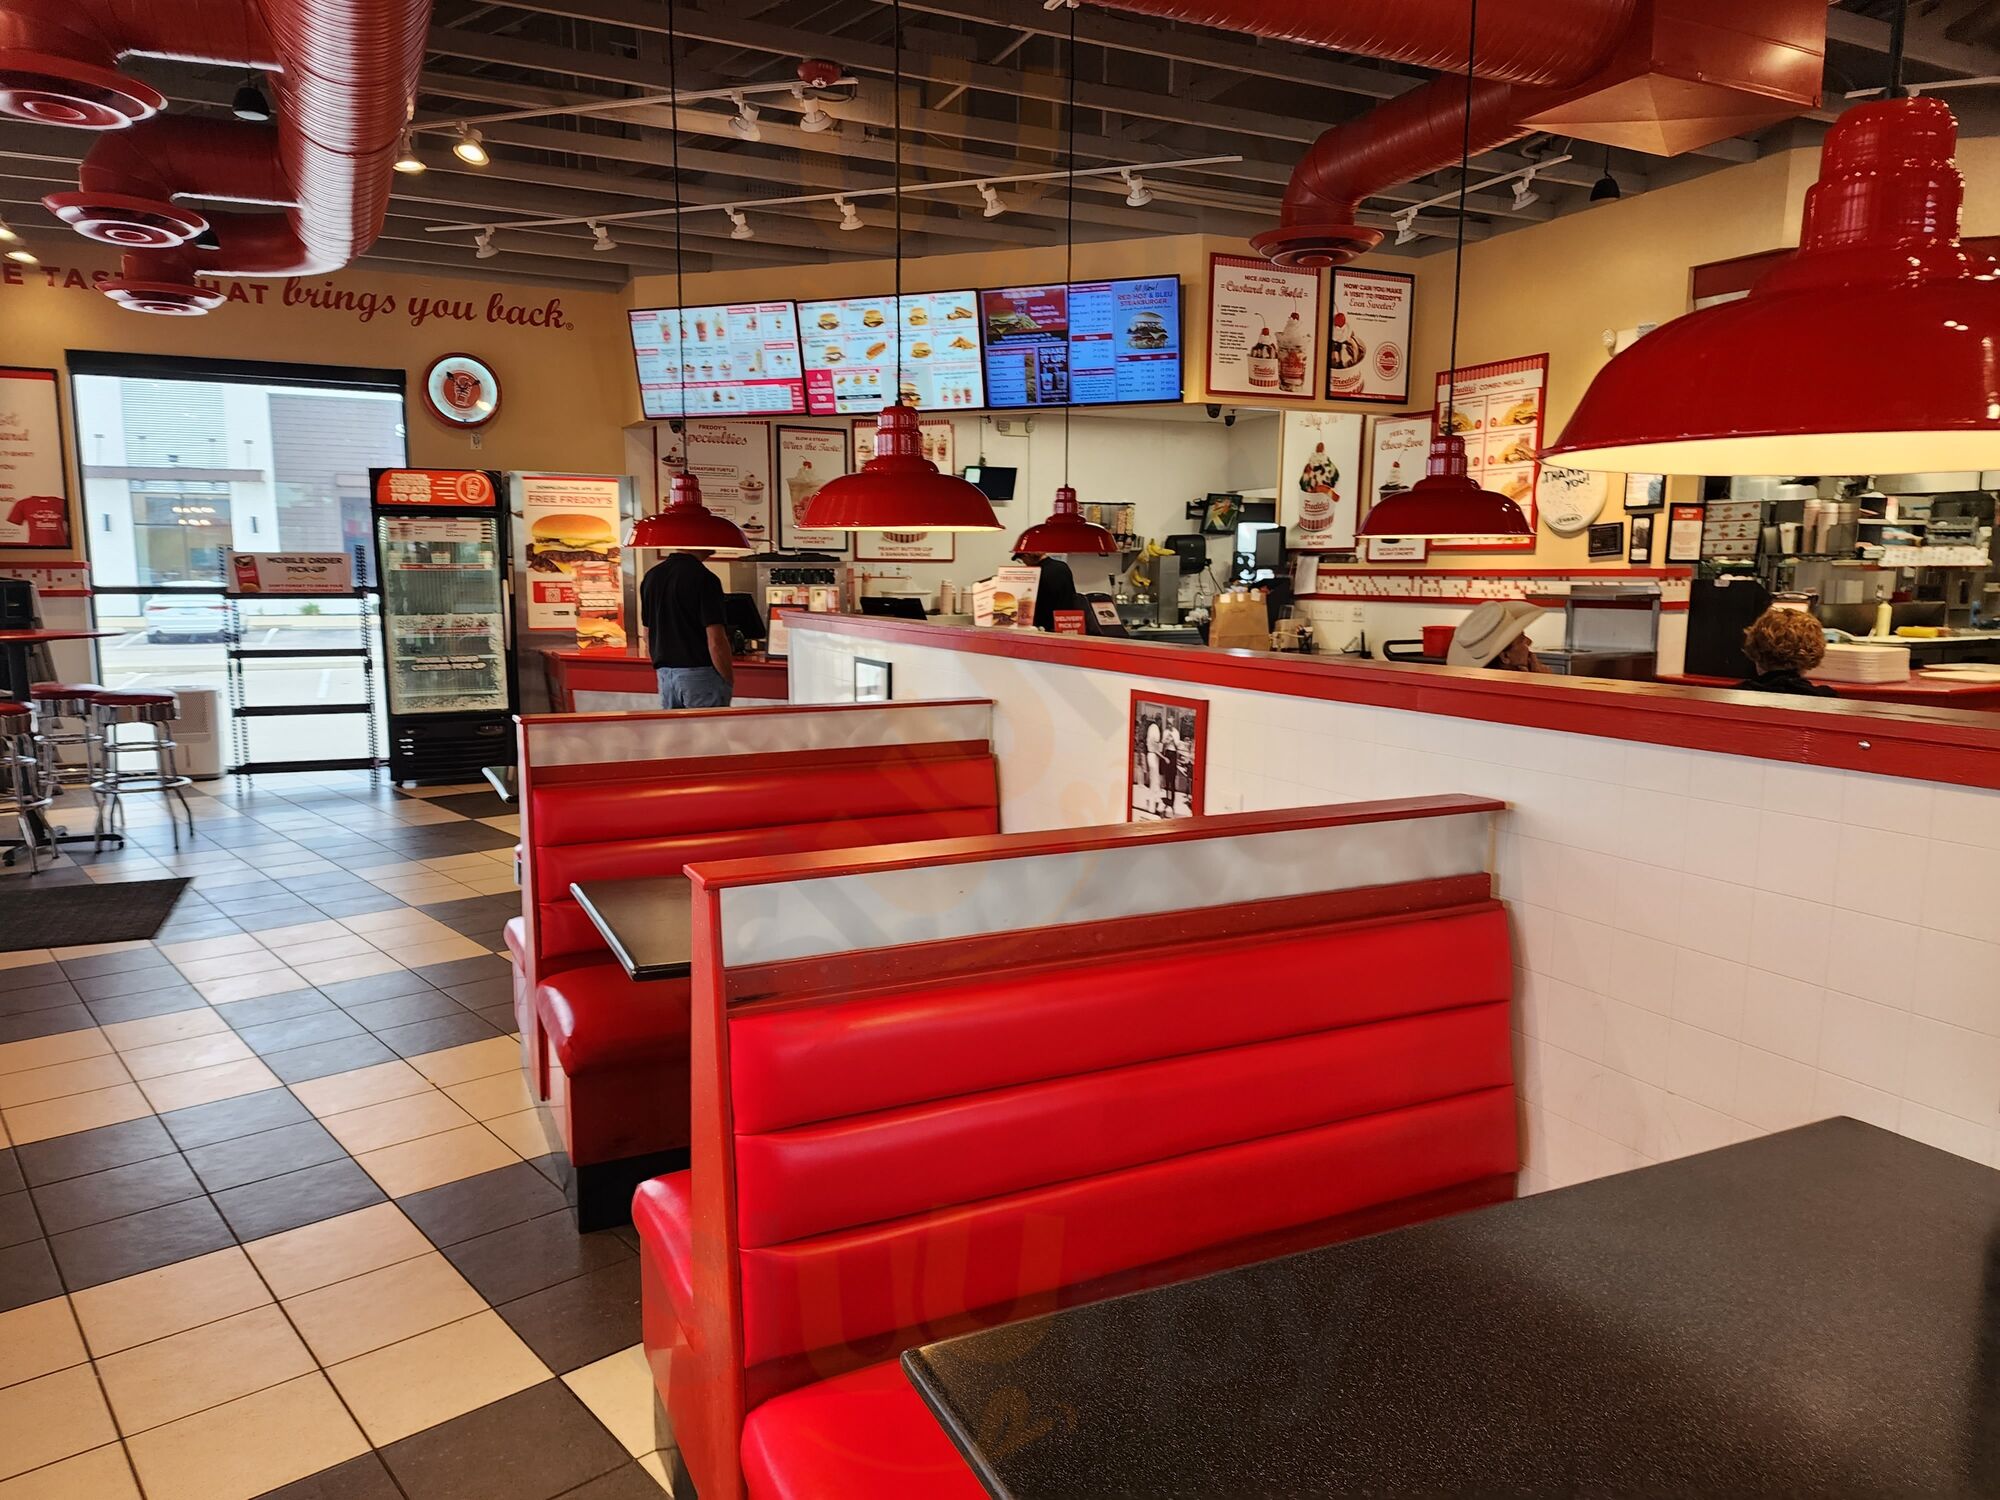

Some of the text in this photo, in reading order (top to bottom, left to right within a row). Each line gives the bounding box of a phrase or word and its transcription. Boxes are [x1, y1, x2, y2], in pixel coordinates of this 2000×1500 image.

[1244, 274, 1258, 282] NICE
[1225, 280, 1304, 299] Custard on Hold
[1343, 282, 1359, 290] HOW
[1385, 287, 1403, 295] MAKE
[1154, 290, 1174, 298] BLEU
[1349, 290, 1365, 298] VISIT
[1374, 293, 1402, 302] FREDDY'S
[282, 276, 397, 323] brings
[408, 297, 477, 327] you
[1119, 297, 1168, 306] STEAKBURGER
[1348, 297, 1397, 311] Even Sweeter?
[1478, 381, 1502, 391] COMBO
[698, 424, 728, 432] FREDDY'S
[1389, 428, 1416, 438] FEEL THE
[782, 440, 803, 450] Wins
[804, 442, 817, 451] the
[688, 465, 716, 473] SIGNATURE
[1564, 472, 1591, 491] YOU!
[390, 493, 408, 502] TO
[528, 494, 613, 505] FREE FREDDY'S
[265, 556, 344, 565] MOBILE ORDER
[286, 565, 328, 574] PICK-UP
